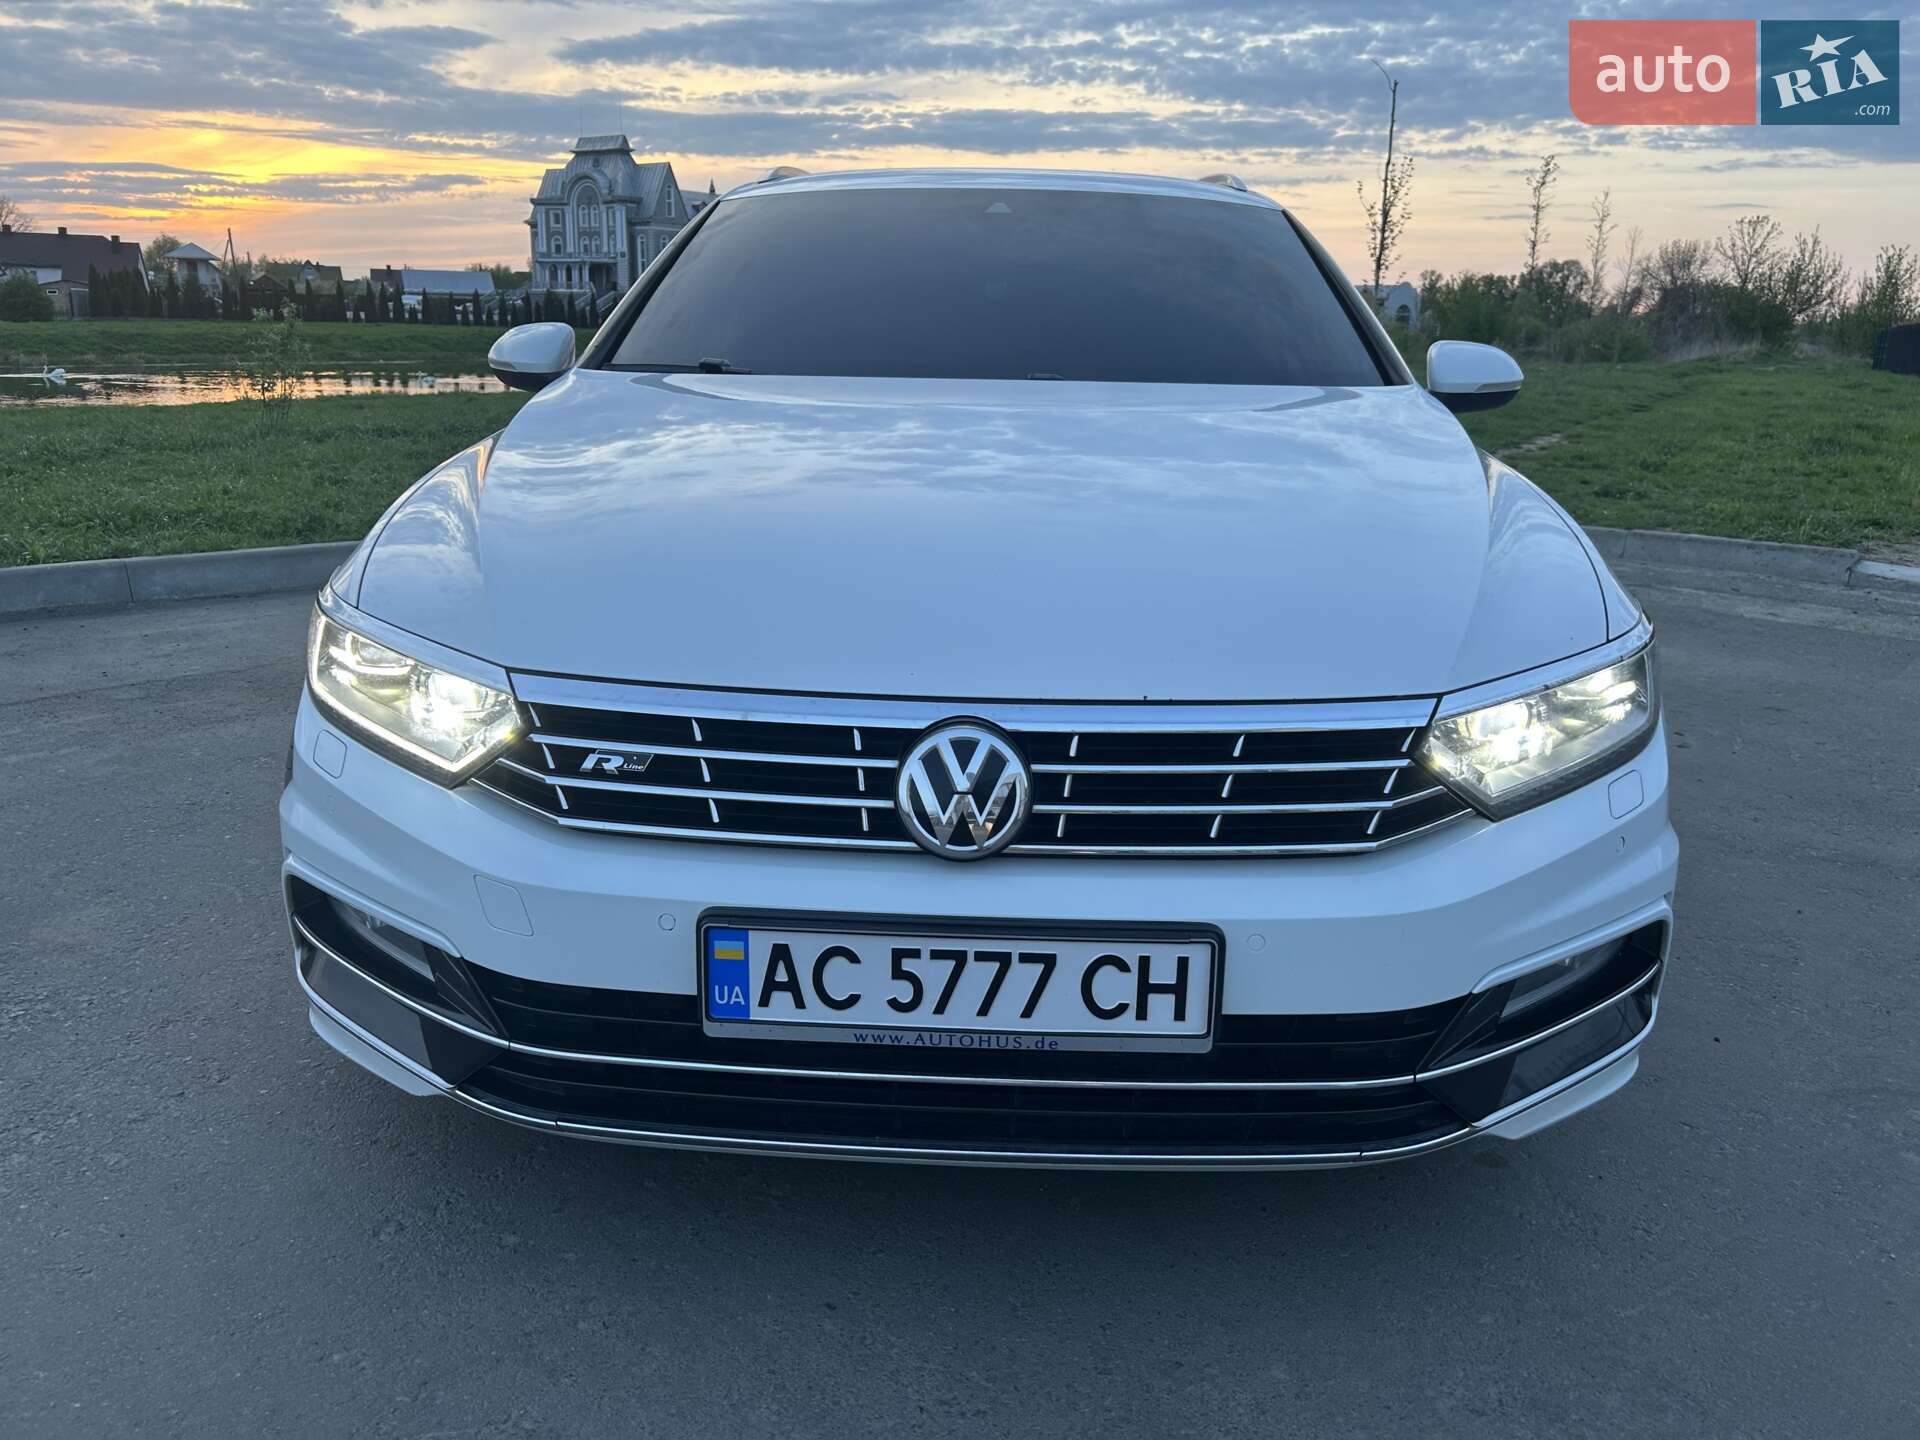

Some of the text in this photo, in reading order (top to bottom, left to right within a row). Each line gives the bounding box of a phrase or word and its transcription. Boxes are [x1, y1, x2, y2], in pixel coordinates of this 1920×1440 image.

[757, 942, 1190, 1021] AC 5777 CH
[714, 985, 746, 1006] UA
[853, 1030, 1059, 1051] www.AUTOHUS.de
